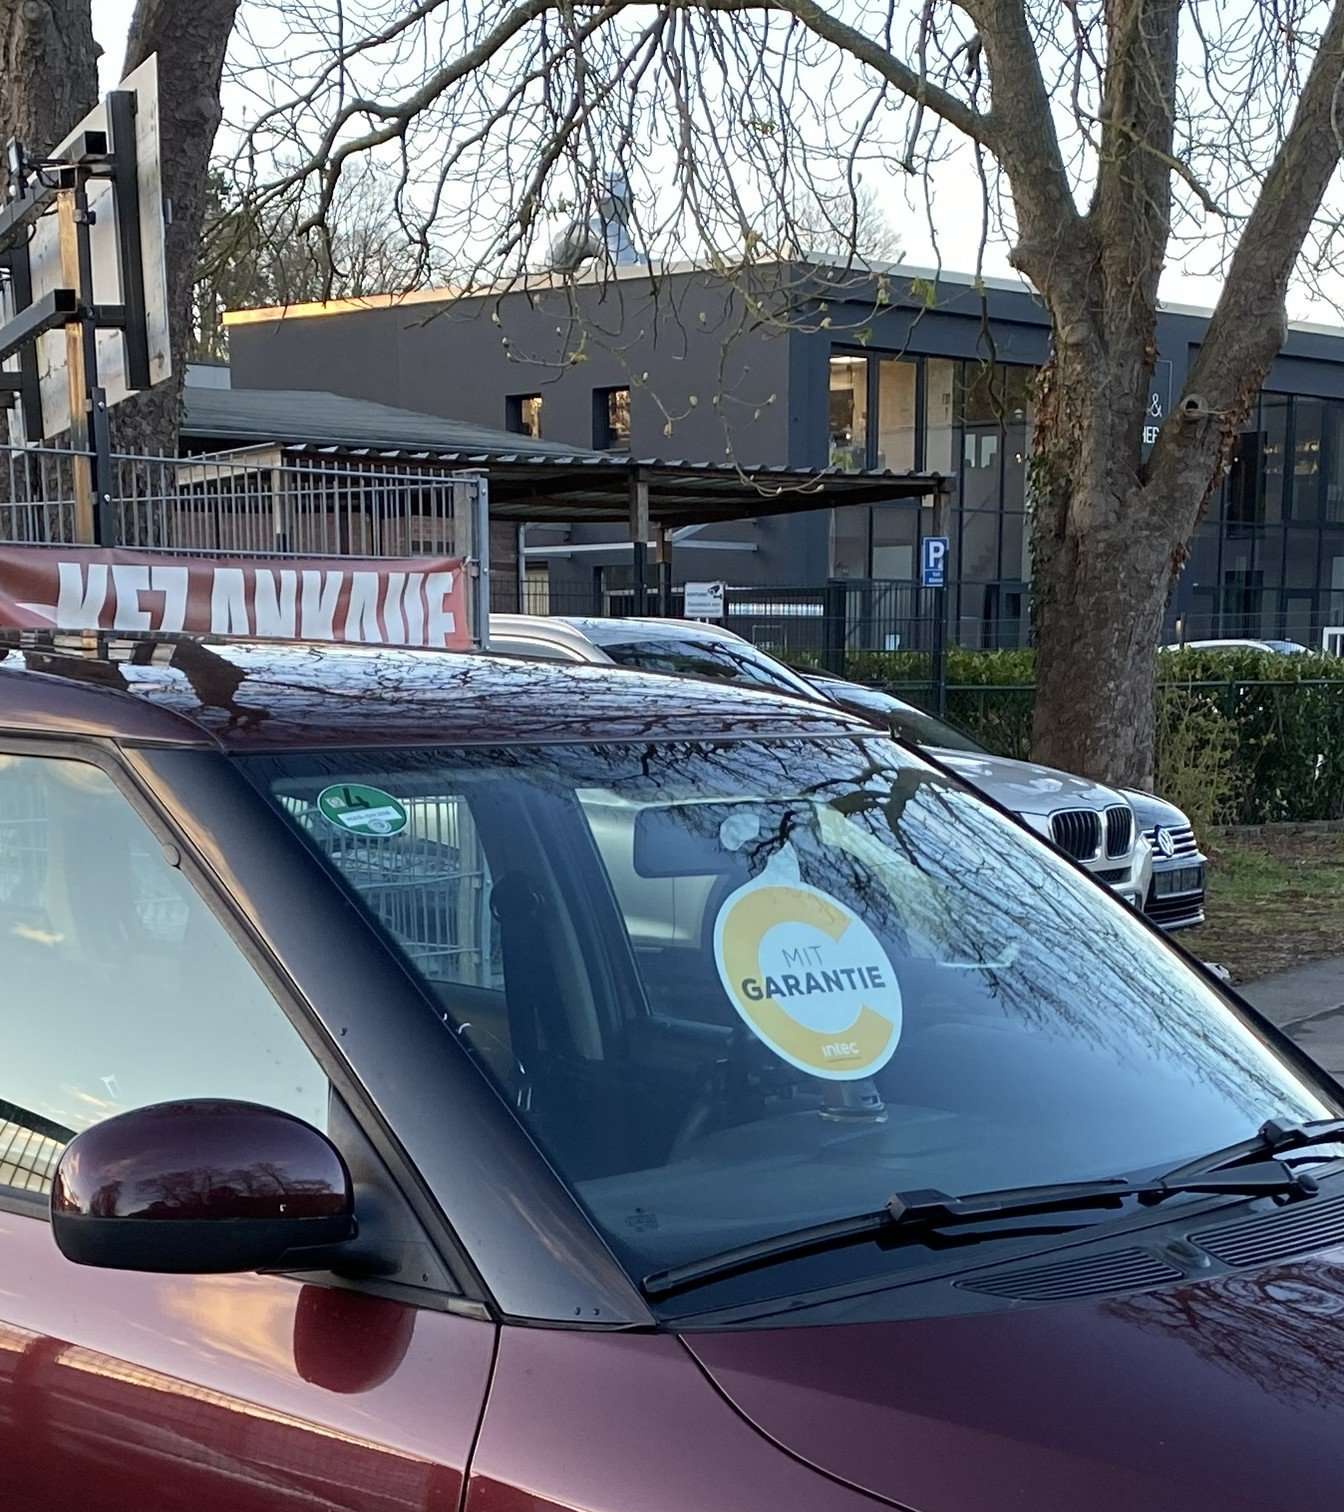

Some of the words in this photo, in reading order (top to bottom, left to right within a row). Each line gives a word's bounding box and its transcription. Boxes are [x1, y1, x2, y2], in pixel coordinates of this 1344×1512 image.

[929, 541, 944, 567] P
[342, 787, 370, 808] 4
[782, 945, 824, 968] MIT
[741, 965, 886, 1001] GARANTIE
